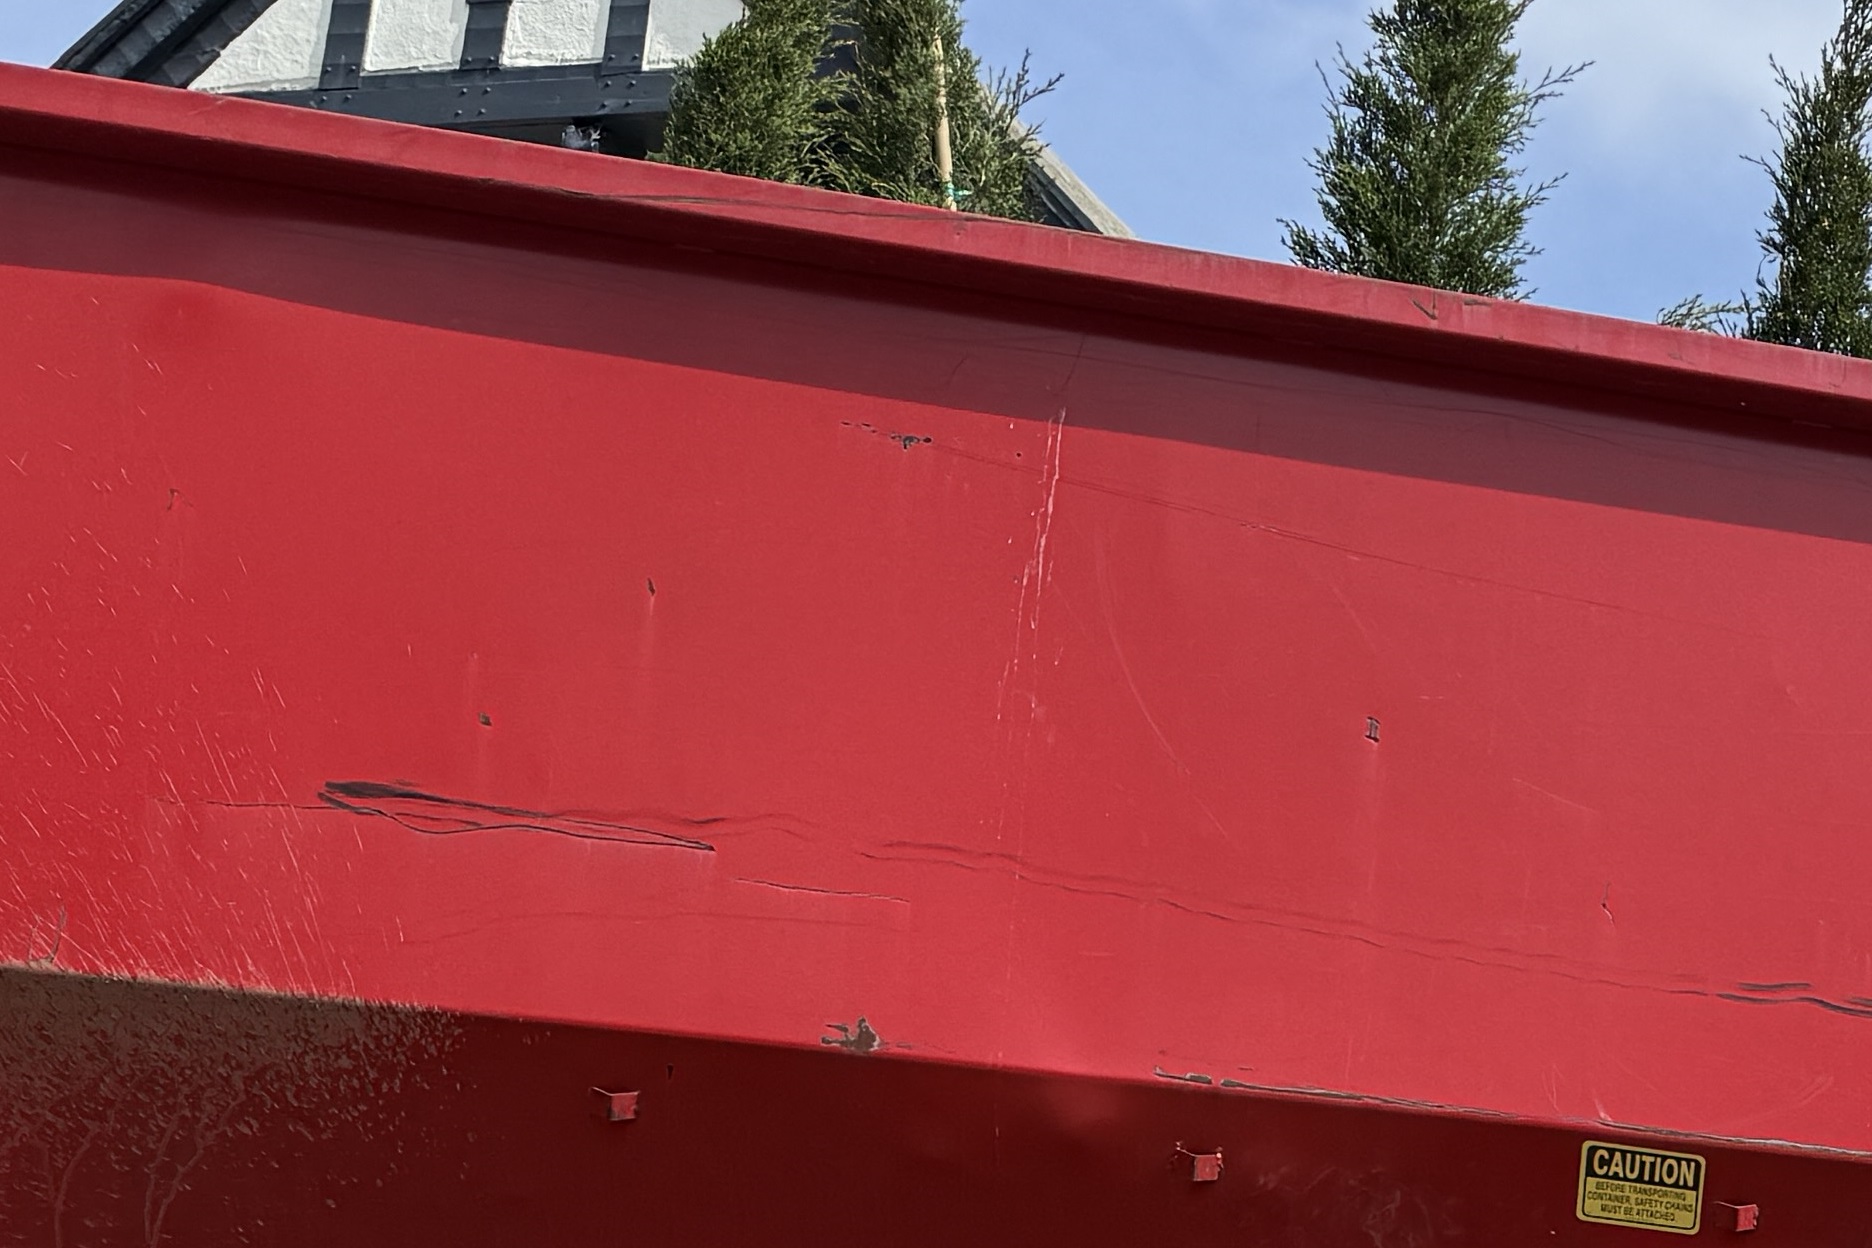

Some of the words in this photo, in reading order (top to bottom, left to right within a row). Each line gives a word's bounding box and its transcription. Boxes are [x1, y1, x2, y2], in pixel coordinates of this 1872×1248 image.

[1593, 1149, 1695, 1187] CAUTION
[1595, 1181, 1626, 1194] BEFORE
[1628, 1185, 1687, 1201] TRANSPORTING
[1600, 1204, 1622, 1215] MUST
[1623, 1207, 1634, 1217] BE
[1635, 1197, 1663, 1210] SAFETY
[1665, 1201, 1693, 1214] CHAINS
